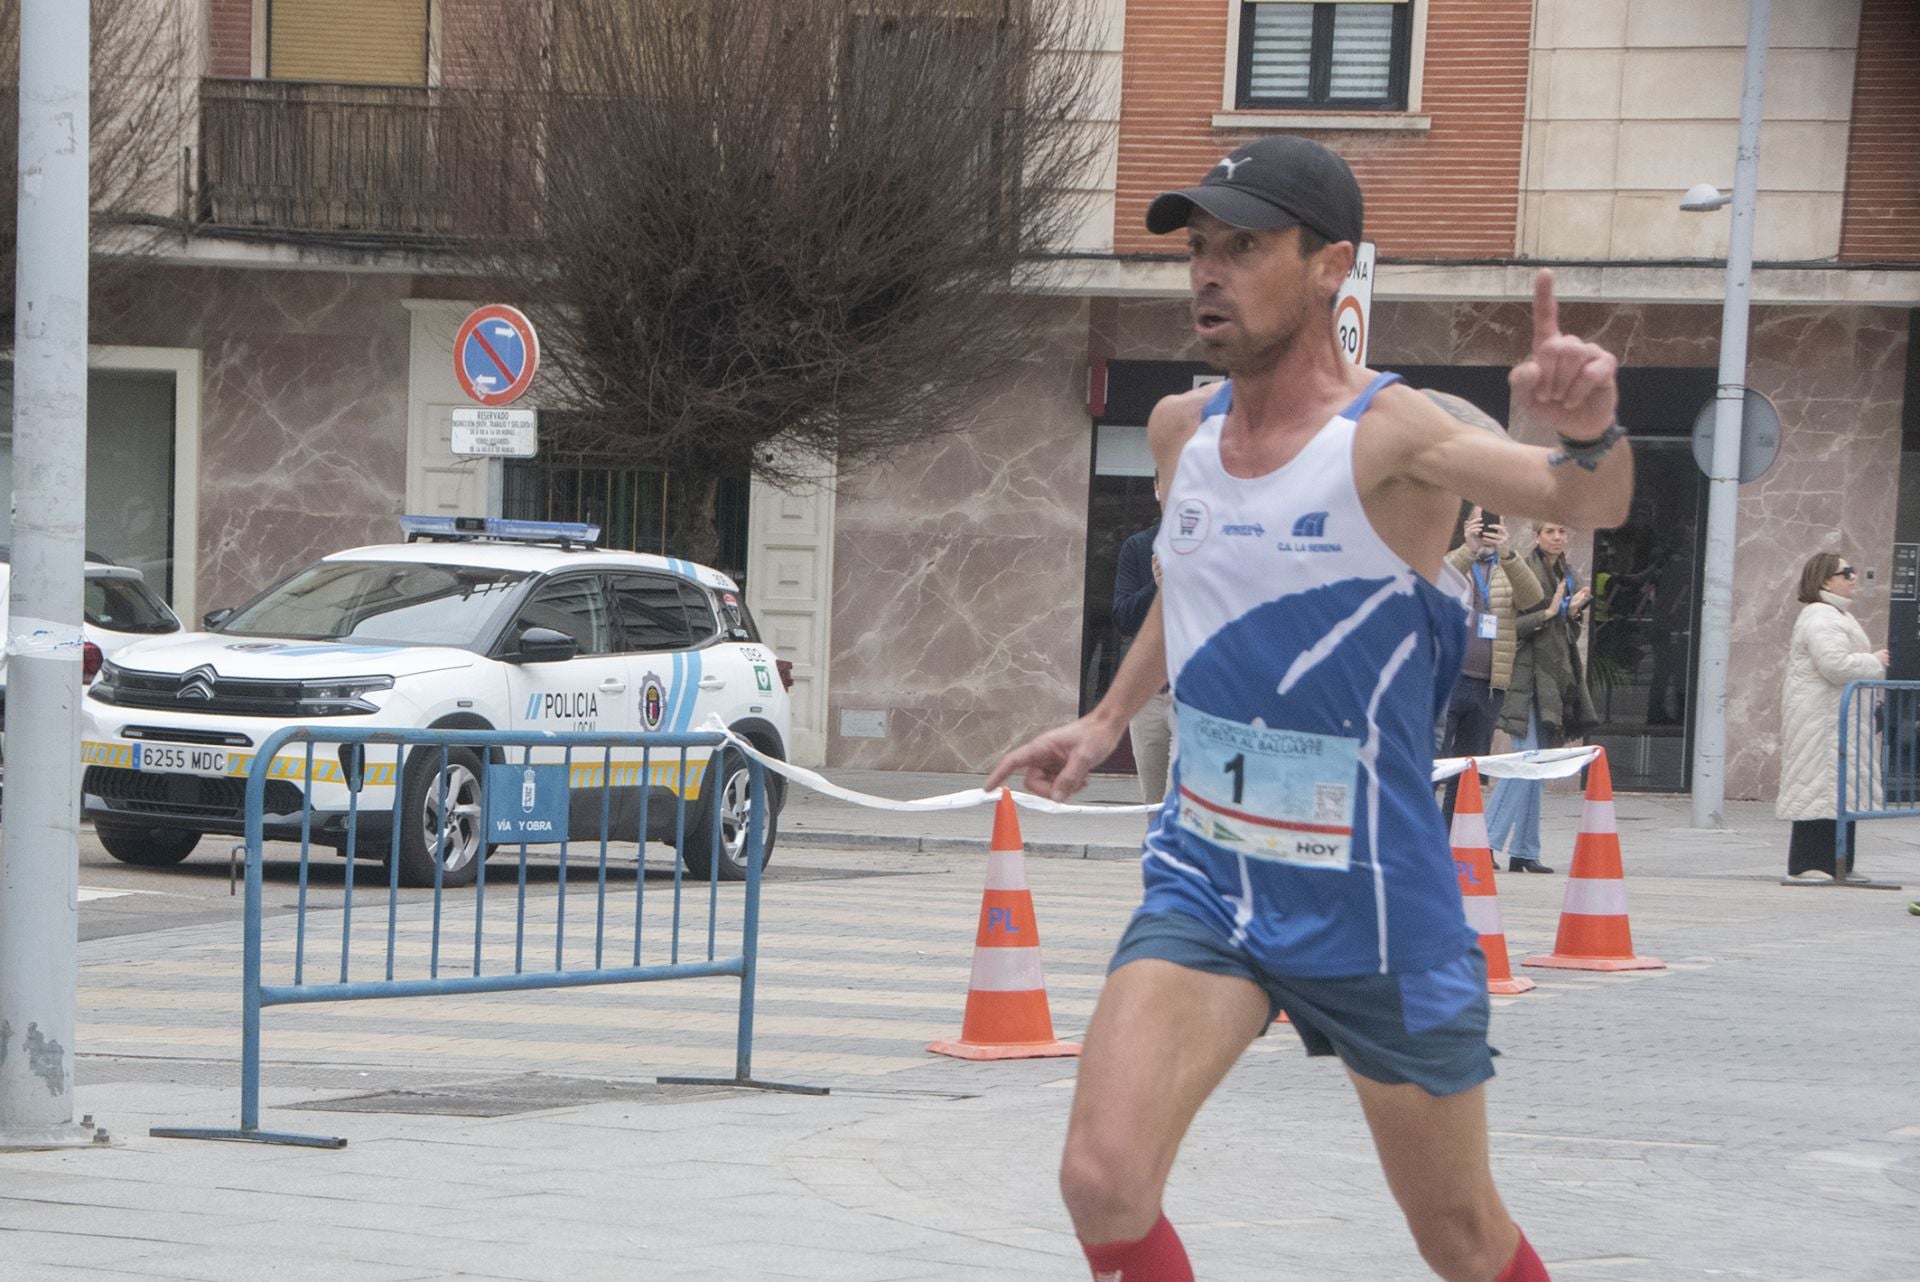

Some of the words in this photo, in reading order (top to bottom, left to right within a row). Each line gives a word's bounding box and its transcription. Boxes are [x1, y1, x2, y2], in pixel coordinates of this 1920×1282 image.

[1339, 325, 1358, 354] 30
[477, 411, 509, 420] RESERVADO
[544, 692, 598, 719] POLICIA
[144, 748, 185, 768] 6255
[191, 751, 224, 771] MDC
[1223, 751, 1245, 804] 1
[497, 819, 511, 831] VÍA
[518, 821, 526, 831] Y
[526, 821, 552, 831] OBRA
[1297, 841, 1339, 857] HOY
[1454, 861, 1481, 884] PL
[989, 907, 1020, 933] PL
